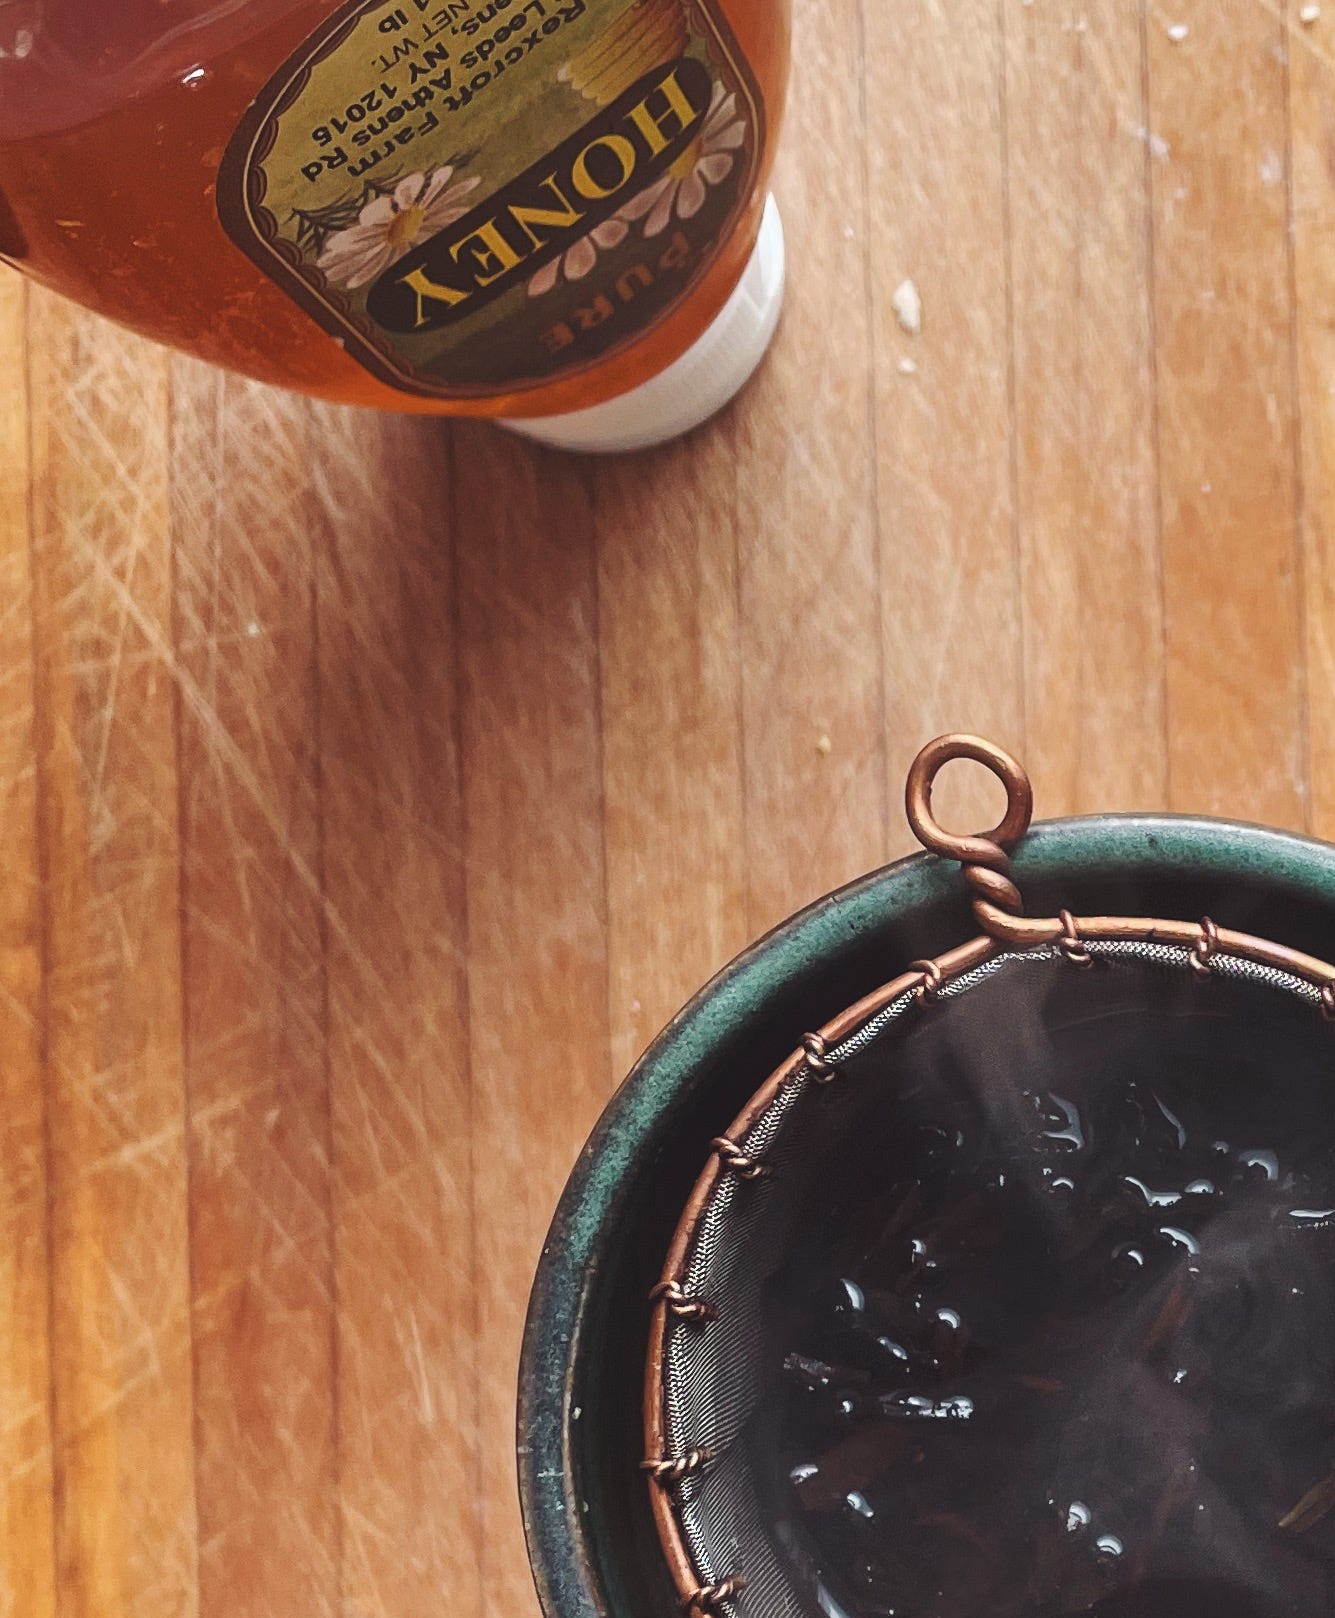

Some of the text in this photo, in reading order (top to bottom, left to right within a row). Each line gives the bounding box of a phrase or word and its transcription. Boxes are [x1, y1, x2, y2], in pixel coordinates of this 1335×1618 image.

[371, 0, 471, 74] NET WT.
[378, 9, 410, 34] lb
[409, 42, 450, 85] NY
[300, 0, 547, 183] Leeds Athens Rd
[312, 83, 397, 147] 12015
[346, 0, 587, 178] Rexcroft Farm
[395, 68, 701, 328] HONEY
[538, 230, 690, 349] PURE
